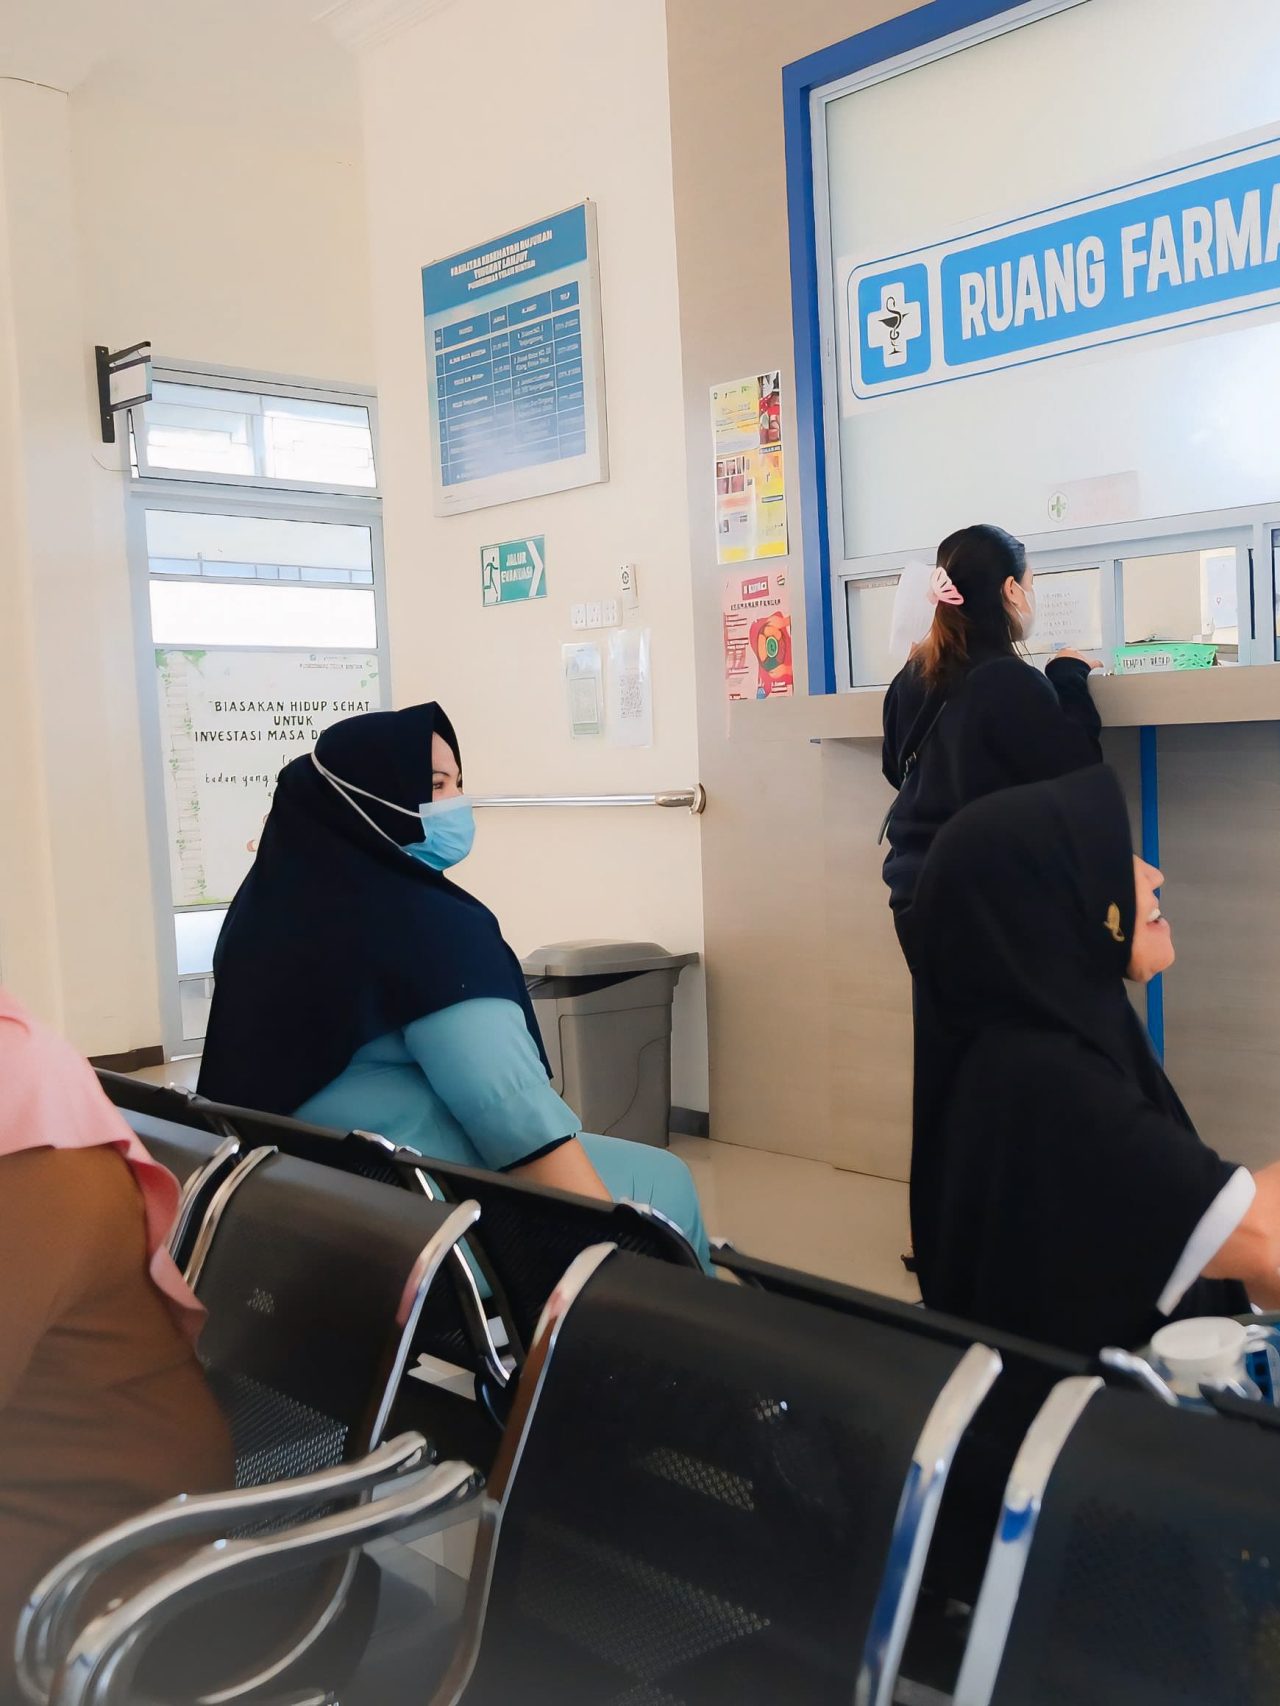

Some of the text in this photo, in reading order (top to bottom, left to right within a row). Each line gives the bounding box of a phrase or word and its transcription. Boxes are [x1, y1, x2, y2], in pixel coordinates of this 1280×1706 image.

[960, 235, 1106, 340] RUANG
[290, 700, 328, 712] HIDUP
[332, 700, 370, 712] SEHAT
[273, 715, 313, 726] UNTUK
[194, 730, 262, 742] INVESTASI
[267, 730, 305, 741] MASA
